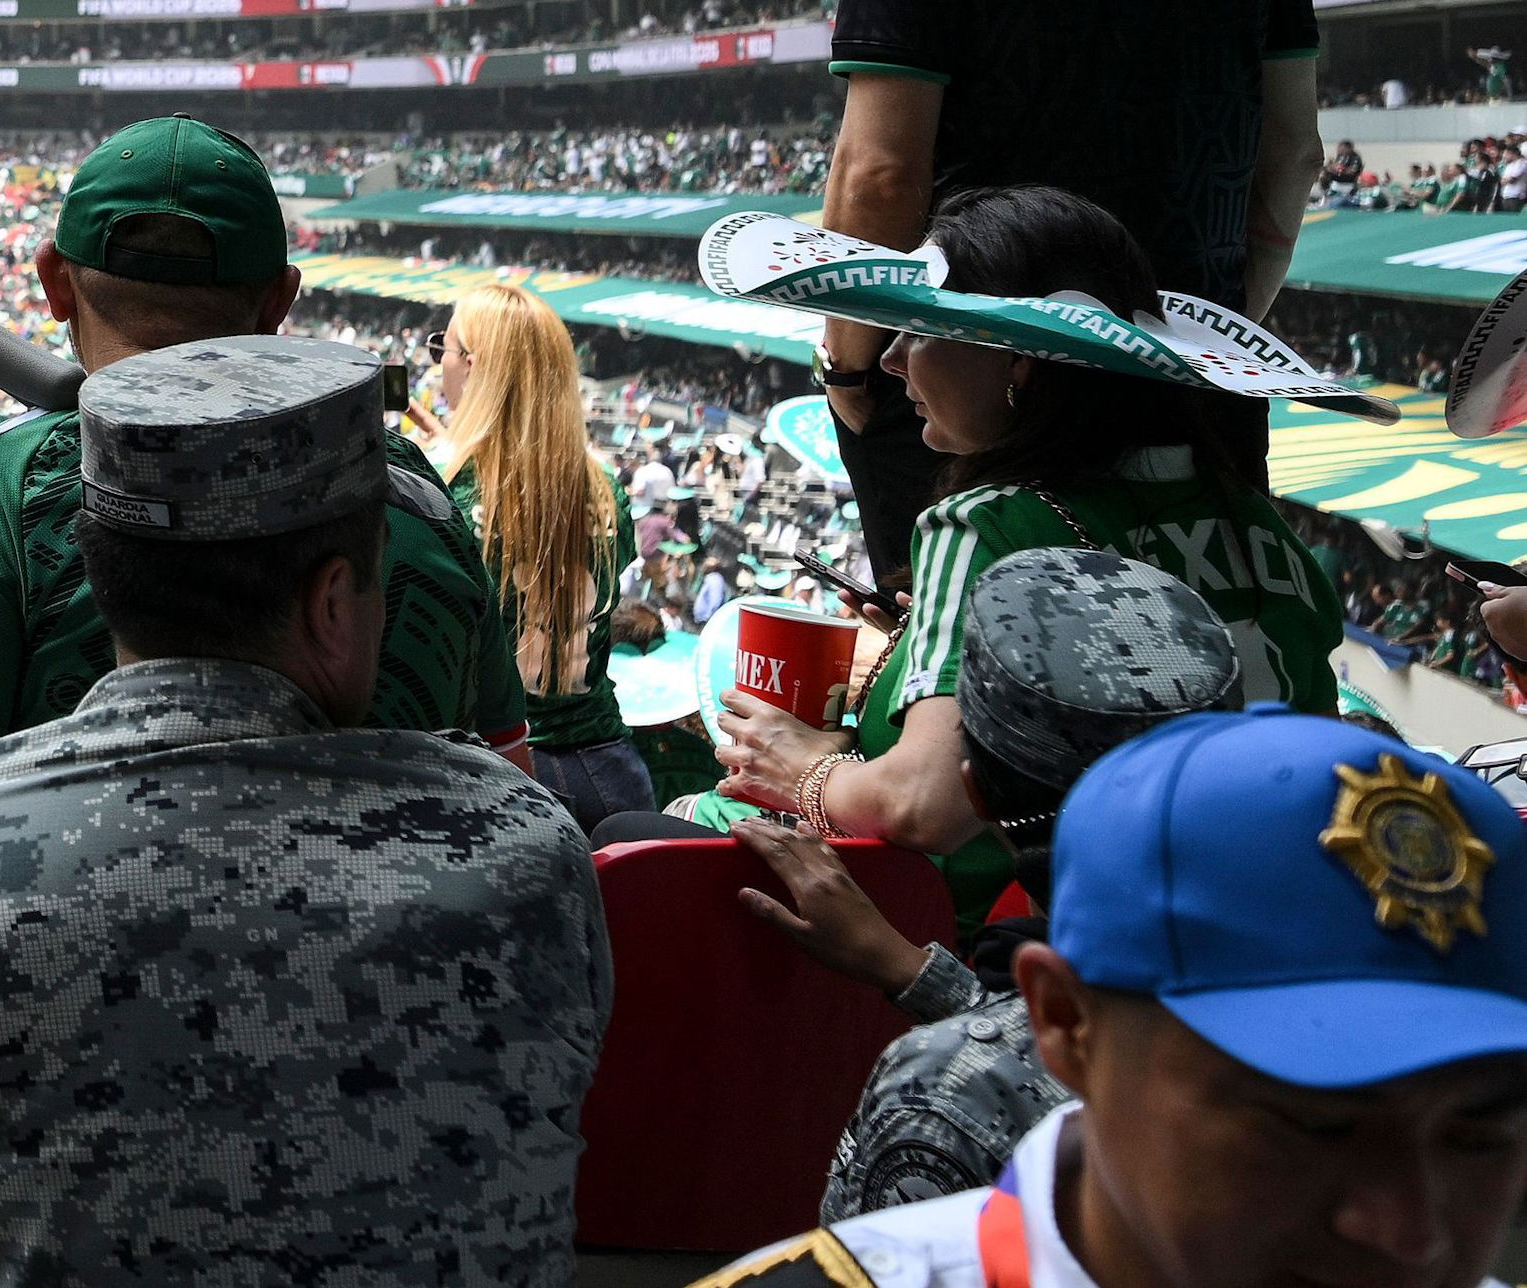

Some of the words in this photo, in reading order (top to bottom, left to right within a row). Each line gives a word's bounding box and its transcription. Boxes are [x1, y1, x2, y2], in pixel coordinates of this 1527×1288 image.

[873, 266, 930, 287] FIFA
[94, 501, 157, 524] NACIONAL
[96, 493, 150, 513] GUARDIA
